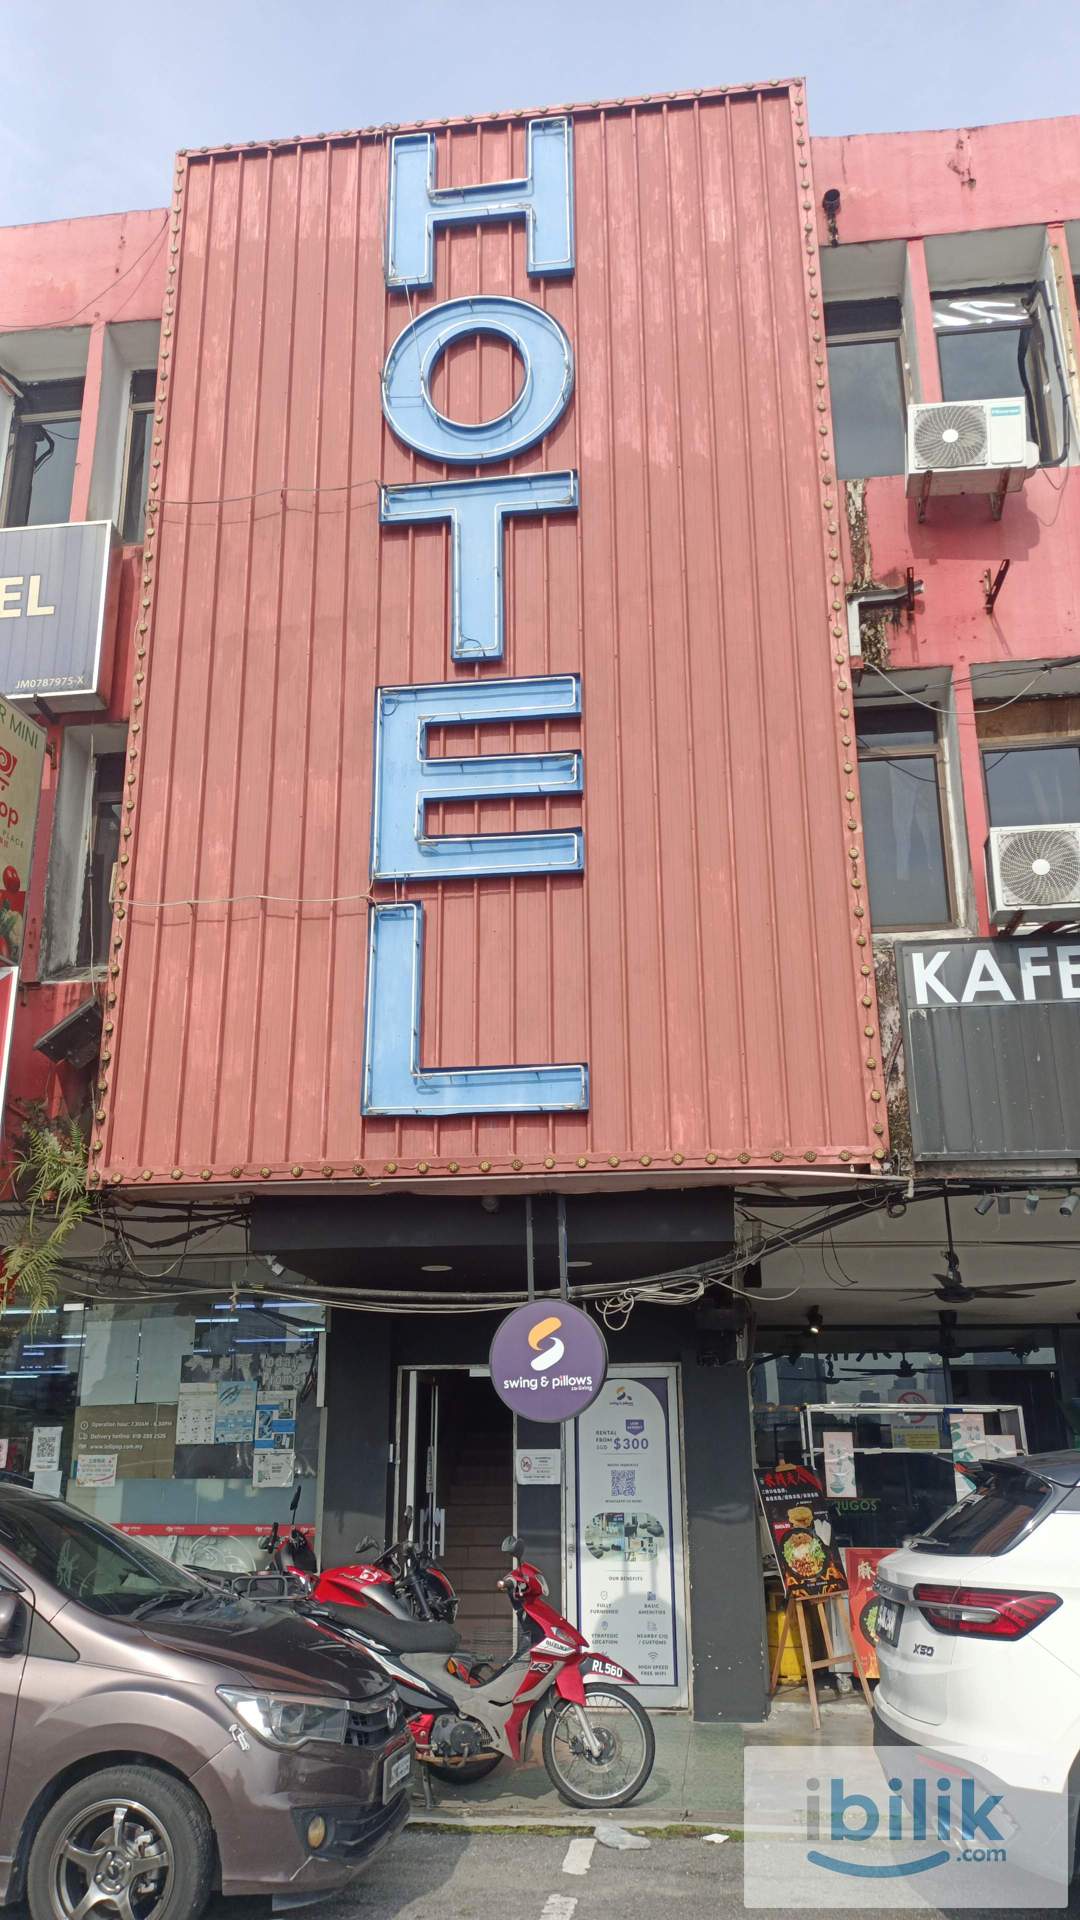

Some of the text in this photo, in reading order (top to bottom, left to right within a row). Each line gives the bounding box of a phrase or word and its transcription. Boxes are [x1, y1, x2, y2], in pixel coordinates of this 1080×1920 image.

[361, 116, 589, 1116] HOTEL
[16, 676, 84, 689] JM0787975-X
[10, 713, 38, 750] MINI
[503, 1375, 592, 1391] swing & pillows
[613, 1437, 649, 1450] $300
[913, 1643, 935, 1656] X50
